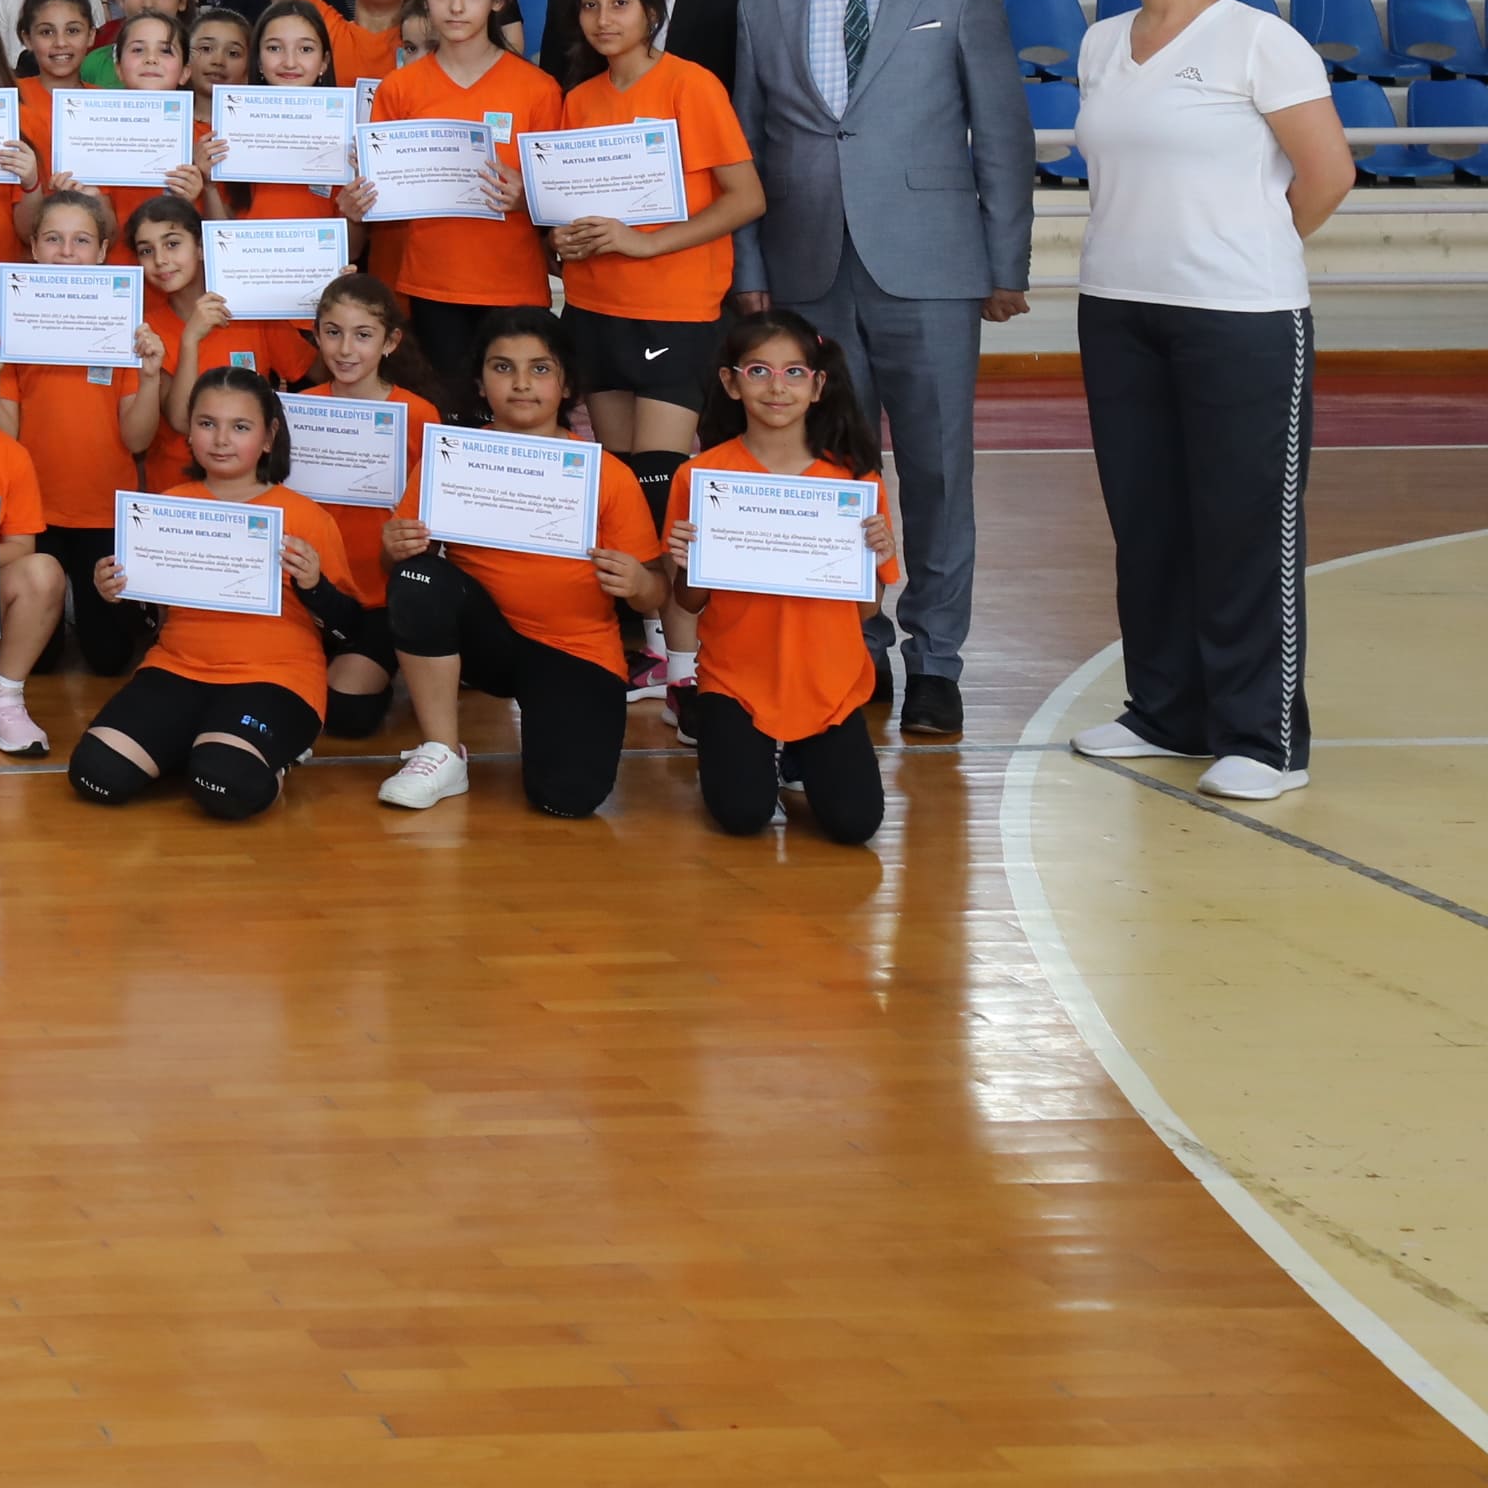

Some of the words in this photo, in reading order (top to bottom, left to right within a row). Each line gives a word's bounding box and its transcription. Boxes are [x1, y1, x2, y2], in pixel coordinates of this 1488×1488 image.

[389, 131, 427, 140] NARLIDERE
[554, 138, 596, 151] NARLIDERE
[563, 156, 595, 164] KATILIM
[235, 230, 274, 239] NARLIDERE
[29, 275, 68, 284] NARLIDERE
[288, 405, 328, 417] NARLIDERE
[294, 424, 325, 432] KATILIM
[462, 441, 509, 456] NARLIDERE
[468, 462, 504, 473] KATILIM
[732, 485, 781, 498] NARLIDERE
[153, 508, 197, 521] NARLIDERE
[739, 506, 777, 515] KATILIM
[159, 527, 193, 536] KATILIM
[400, 569, 432, 585] ALLSIX
